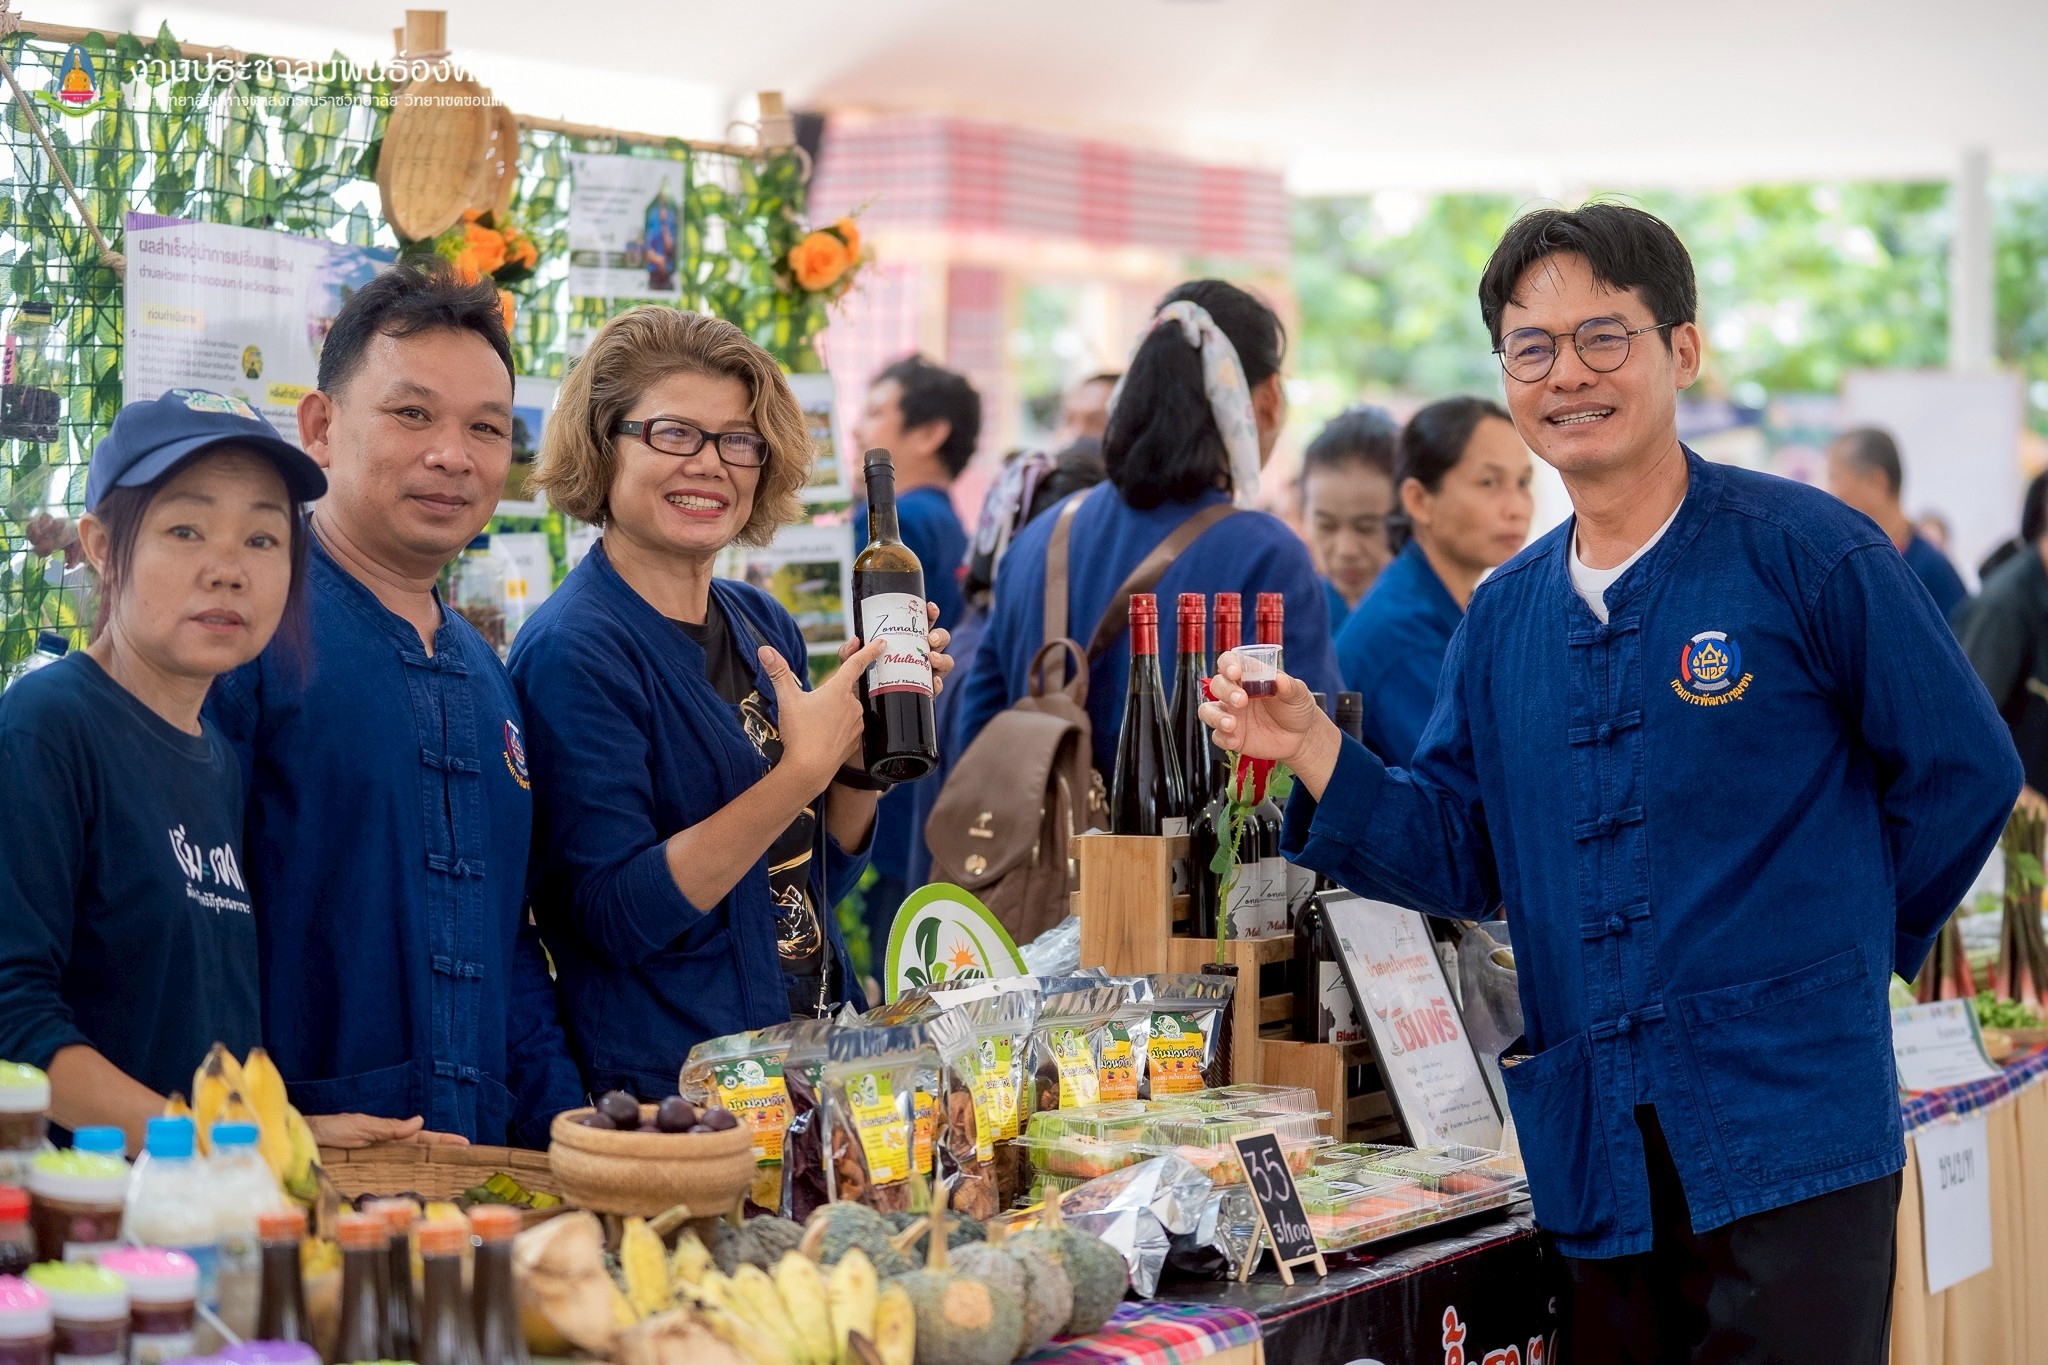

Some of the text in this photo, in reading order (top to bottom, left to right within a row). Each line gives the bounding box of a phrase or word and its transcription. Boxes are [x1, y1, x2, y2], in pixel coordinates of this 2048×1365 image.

[1391, 996, 1459, 1052] ชิมฟรี
[1243, 1147, 1290, 1202] 35
